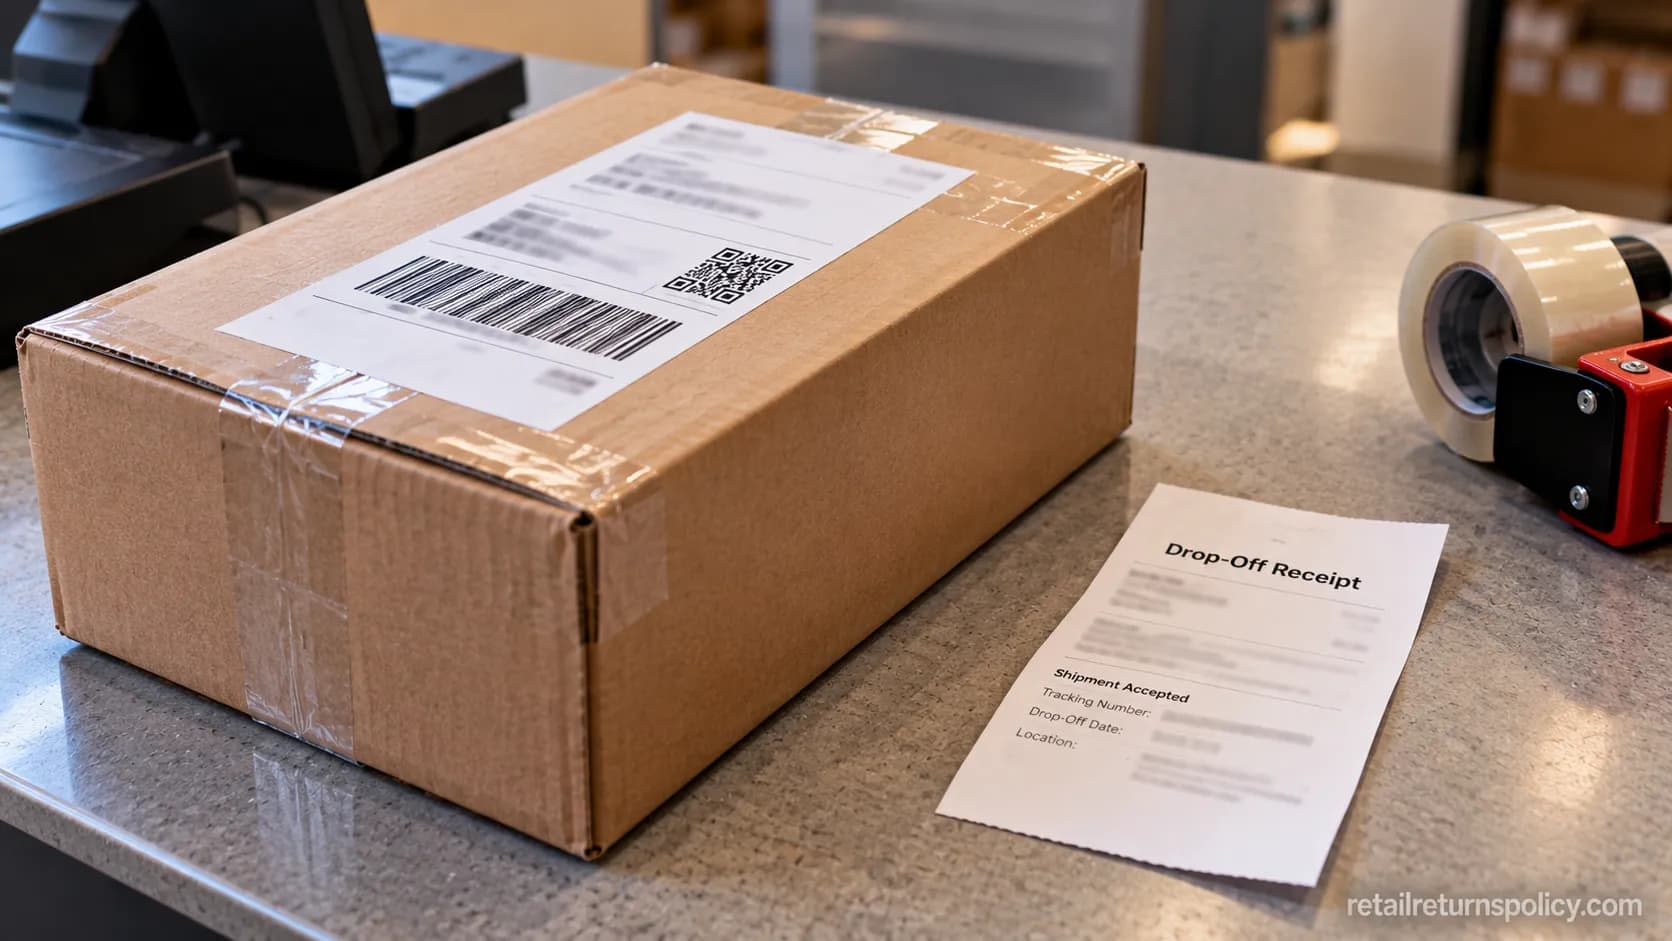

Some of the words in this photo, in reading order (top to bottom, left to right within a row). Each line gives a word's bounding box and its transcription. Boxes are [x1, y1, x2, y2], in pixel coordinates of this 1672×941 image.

[1165, 542, 1268, 573] Drop-Off
[1271, 559, 1362, 591] Receipt
[1053, 667, 1121, 693] Shipment
[1123, 679, 1190, 704] Accepted
[1042, 687, 1094, 708] Tracking
[1097, 698, 1152, 718] Number:
[1029, 706, 1087, 729] Drop-Off
[1089, 719, 1124, 735] Date:
[1015, 726, 1078, 749] Location:
